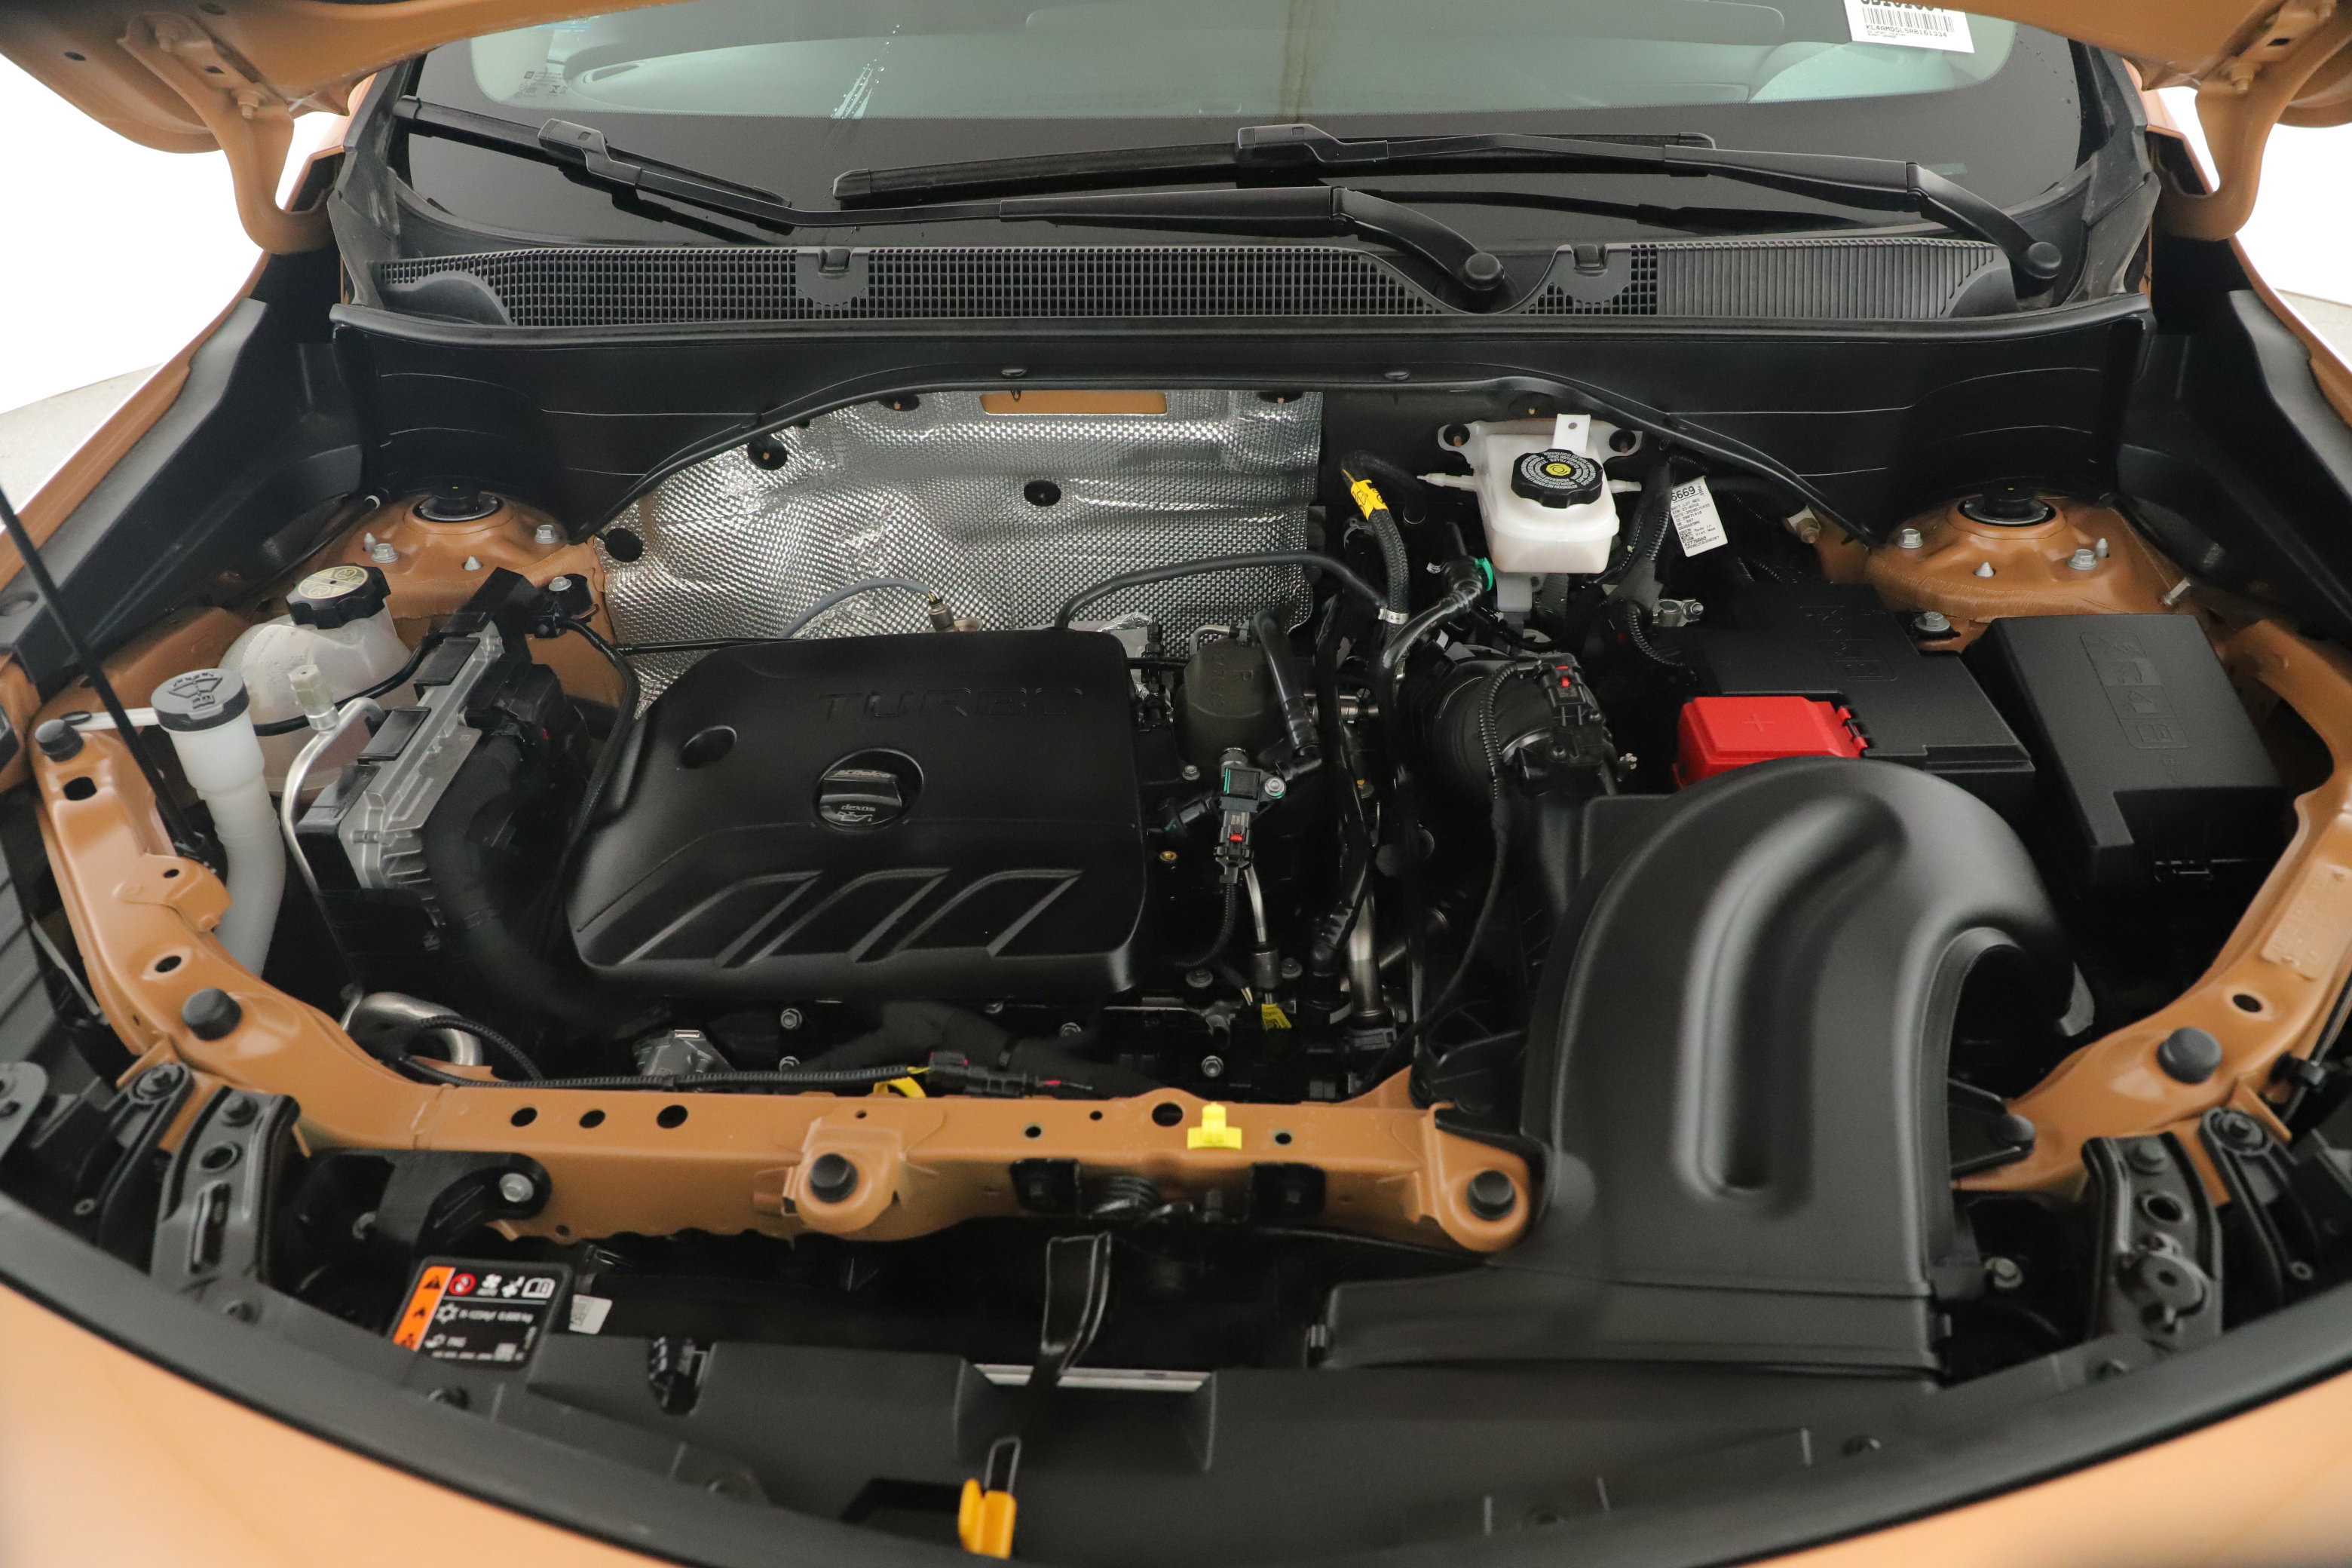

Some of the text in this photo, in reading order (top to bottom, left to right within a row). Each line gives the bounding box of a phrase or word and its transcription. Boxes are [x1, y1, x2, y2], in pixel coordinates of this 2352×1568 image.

[1866, 25, 1947, 38] KL4AMDSL5RB161334
[816, 688, 1084, 719] TURBO
[841, 804, 876, 812] dexos
